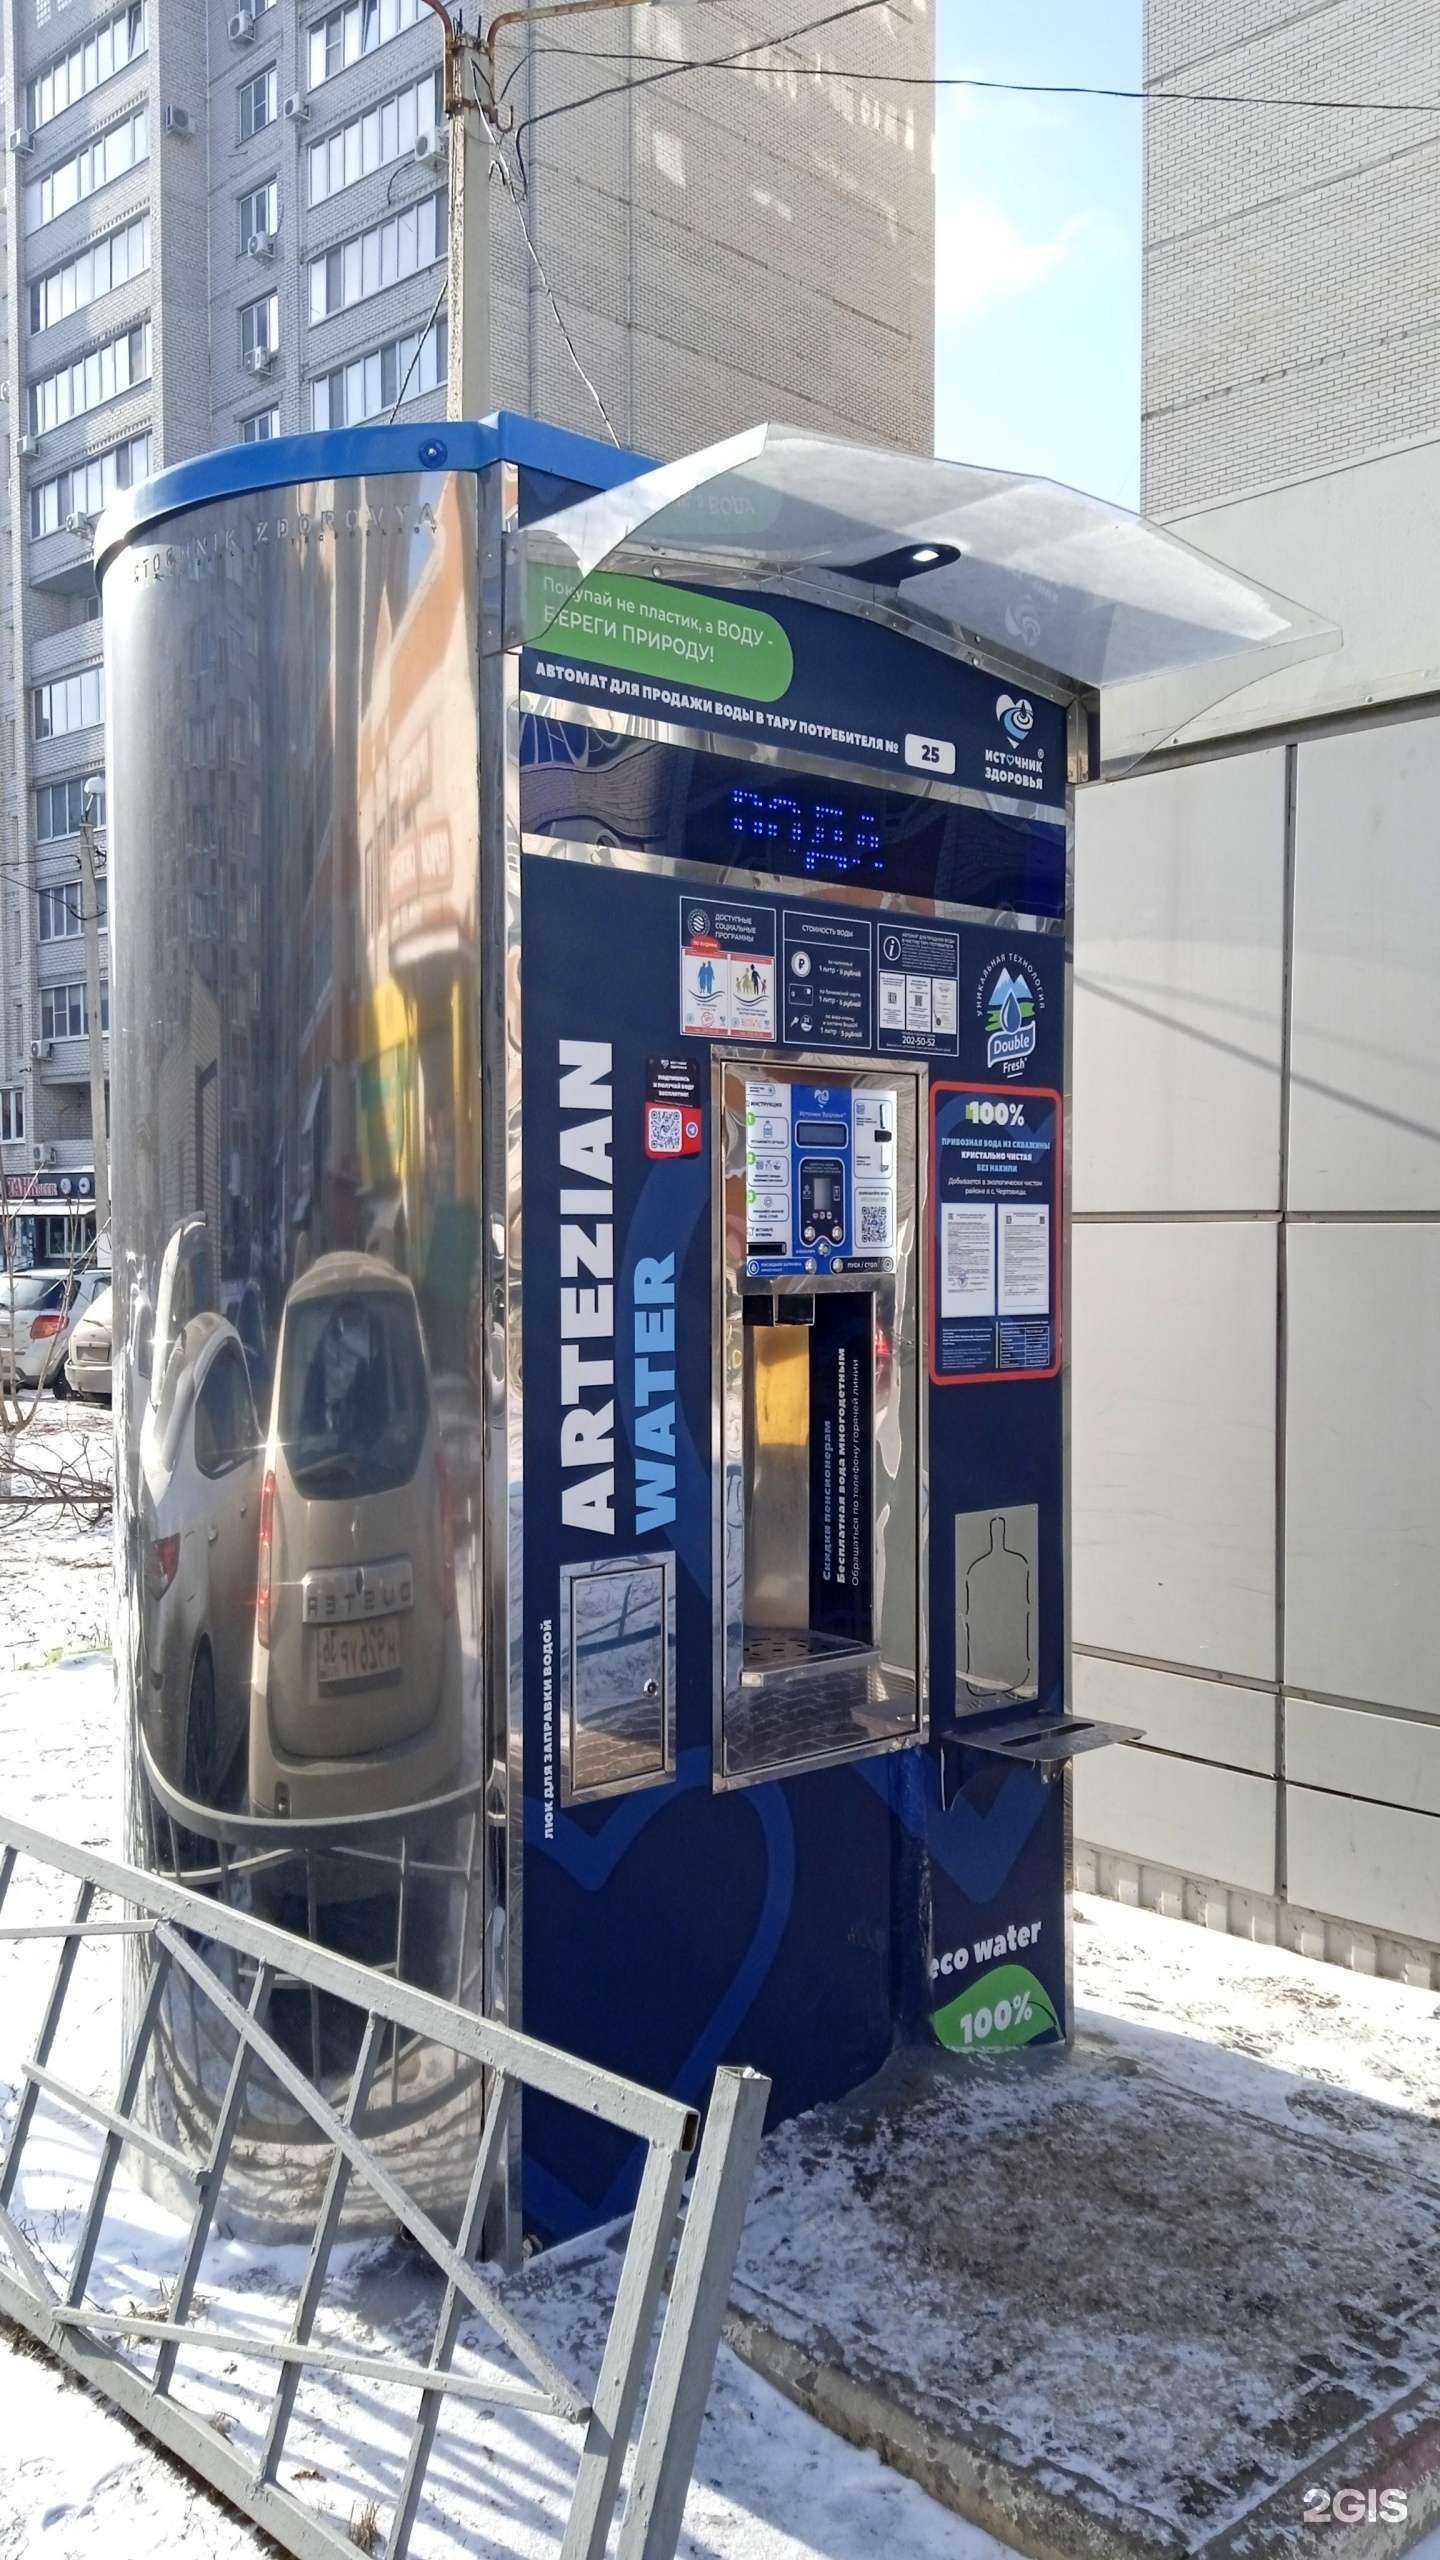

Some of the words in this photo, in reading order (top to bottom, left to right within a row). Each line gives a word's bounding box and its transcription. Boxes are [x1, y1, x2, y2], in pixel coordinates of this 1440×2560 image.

[543, 576, 612, 609] Покупай
[617, 596, 635, 613] не
[640, 604, 702, 633] пластик,
[705, 621, 713, 634] а
[717, 619, 764, 647] ВОДУ
[544, 605, 617, 639] БЕРЕГИ
[623, 624, 715, 663] ПРИРОДУ!
[535, 662, 608, 689] АВТОМАТ
[610, 678, 640, 697] ДЛЯ
[642, 685, 713, 713] ПРОДАЖИ
[715, 702, 754, 723] ВОДЫ
[756, 711, 765, 725] В
[766, 713, 797, 731] ТАРУ
[799, 721, 884, 751] ПОТРЕБИТЕЛЯ
[921, 744, 940, 763] 25
[985, 767, 1042, 790] ЗДОРОВЬЯ
[976, 954, 1006, 1017] УНИКАЛЬНАЯ
[1008, 952, 1046, 1009] ТЕХНОЛОГИЯ
[902, 1035, 936, 1047] 202-50-52
[993, 1034, 1030, 1055] Double
[969, 1101, 1025, 1126] 100%
[942, 1138, 982, 1147] ПРИВОЗНАЯ
[984, 1139, 1001, 1148] ВОДА
[1007, 1153, 1032, 1161] ЧИСТАЯ
[559, 1039, 615, 1536] ARTEZIAN
[634, 1251, 677, 1536] WATER
[837, 1348, 846, 1455] многодетным
[852, 1397, 860, 1442] горячей
[823, 1421, 833, 1522] пенсионерам
[837, 1458, 846, 1493] вода
[852, 1445, 861, 1498] телефону
[853, 1501, 859, 1514] по
[822, 1526, 832, 1581] Скидки
[837, 1497, 846, 1583] Бесплатная
[852, 1517, 861, 1586] Обращаться
[540, 1619, 552, 1676] ВОДОЙ
[543, 1679, 554, 1762] ЗАПРАВКИ
[544, 1765, 555, 1799] ДЛЯ
[544, 1801, 554, 1839] ЛЮК
[928, 1948, 969, 1980] eco
[974, 1921, 1041, 1963] water
[960, 1991, 1032, 2044] 100%
